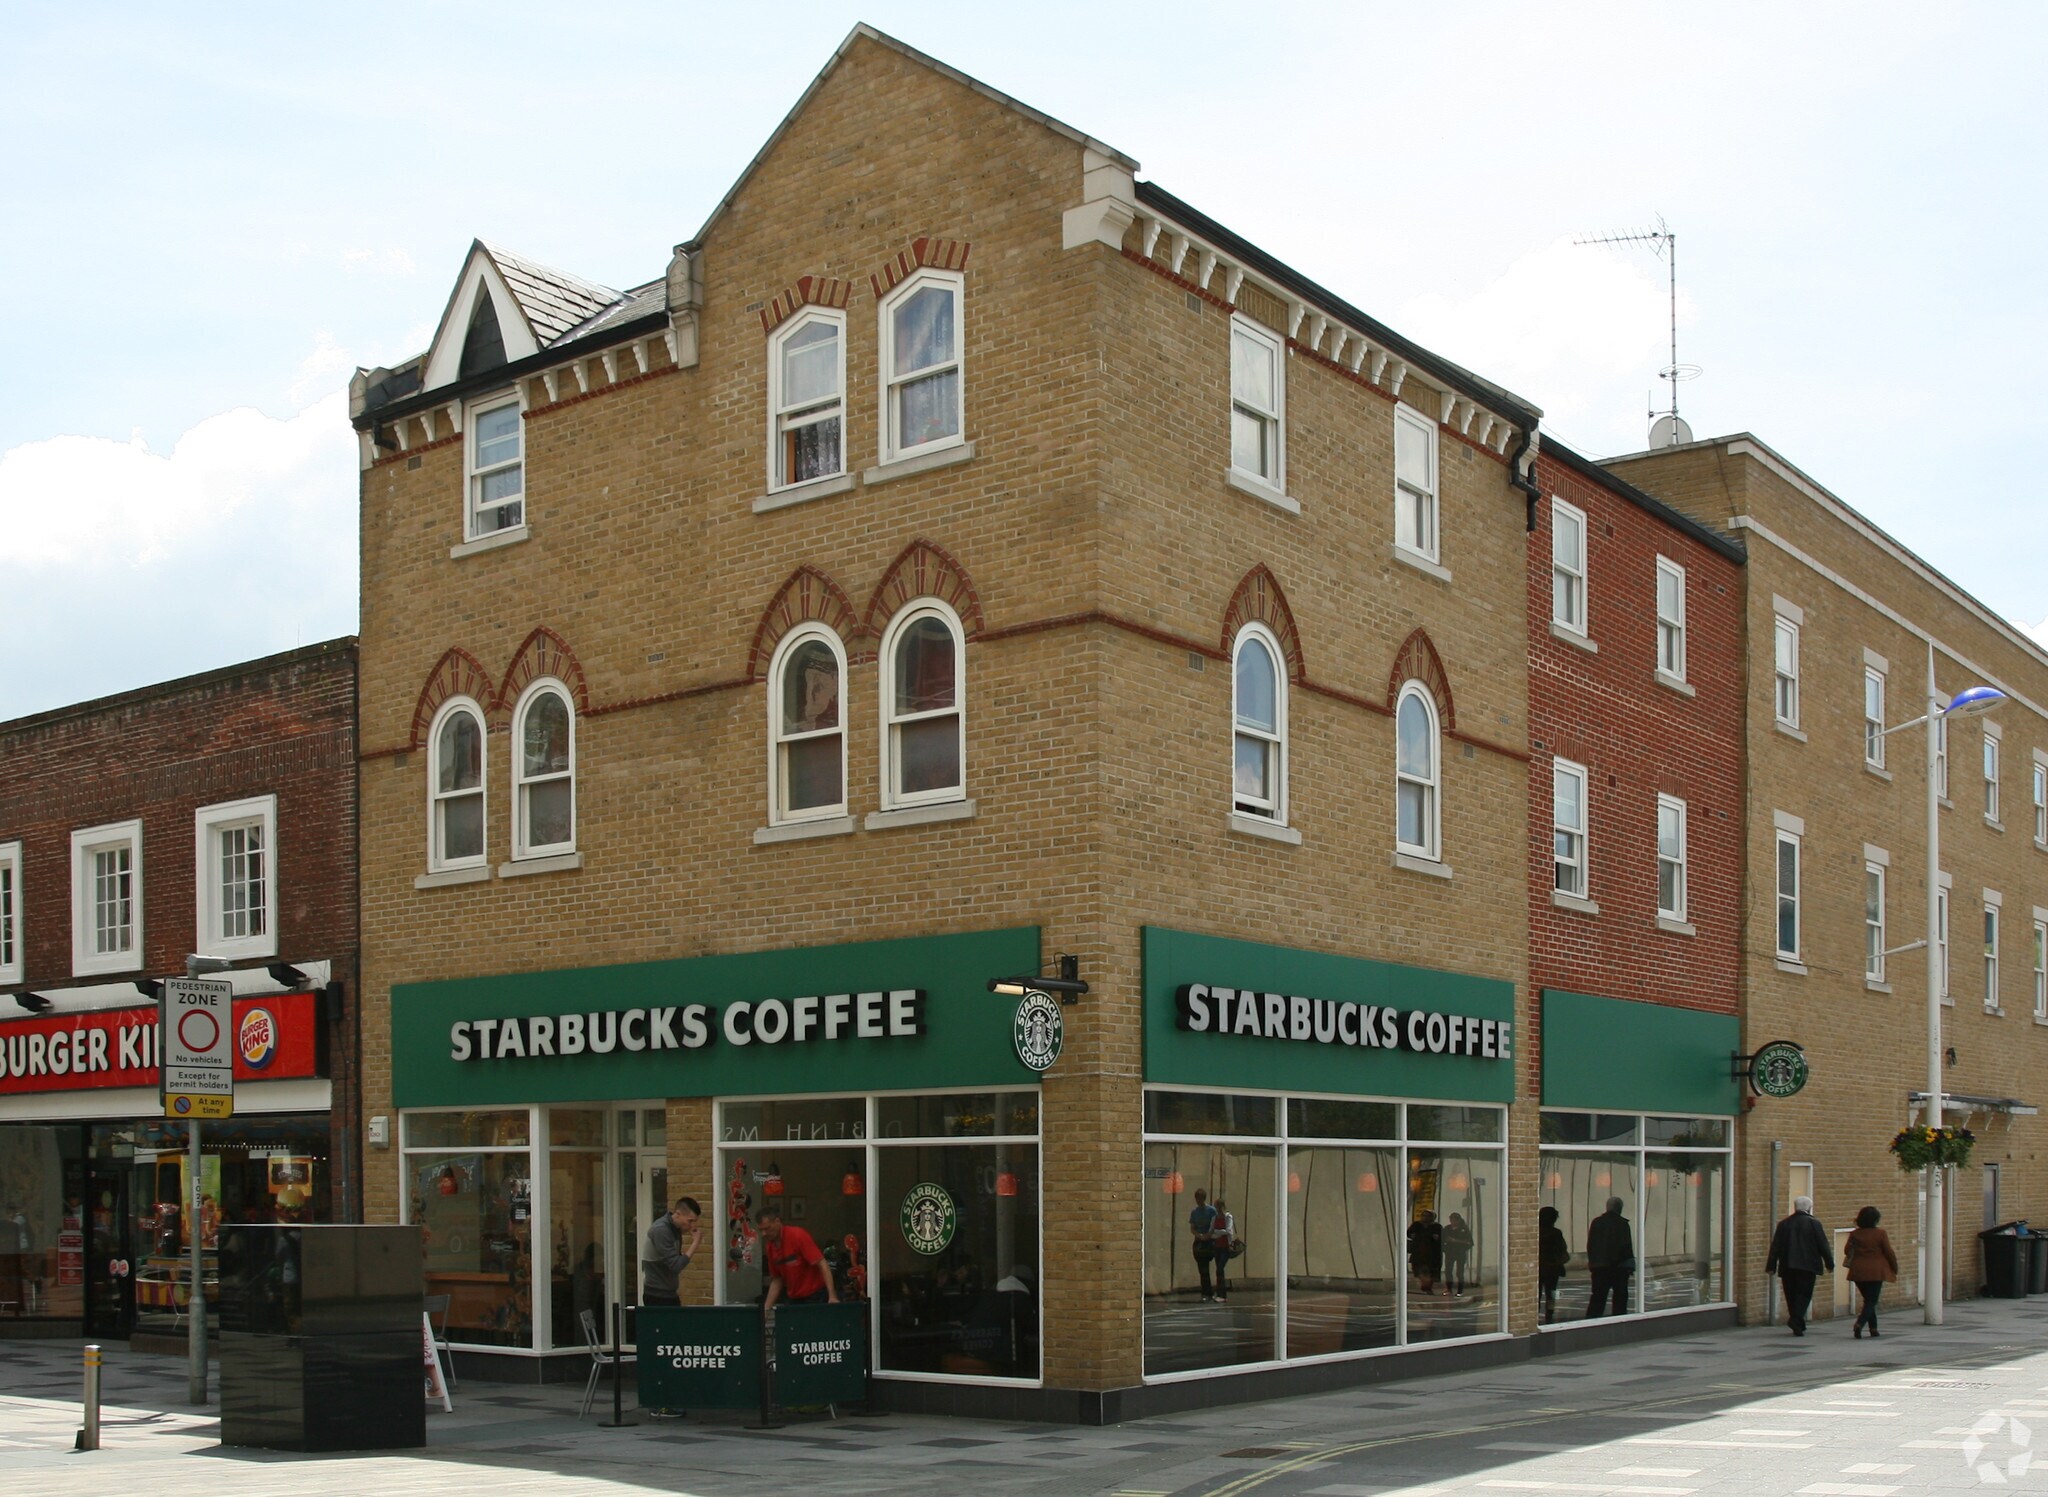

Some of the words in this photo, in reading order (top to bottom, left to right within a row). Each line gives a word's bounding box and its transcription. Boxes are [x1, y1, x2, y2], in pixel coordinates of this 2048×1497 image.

[170, 982, 226, 993] PEDESTRIAN
[178, 993, 218, 1006] ZONE
[1017, 995, 1061, 1029] STARBUCKS
[450, 1004, 709, 1062] STARBUCKS
[722, 989, 917, 1046] COFFEE
[1188, 983, 1399, 1049] STARBUCKS
[1407, 1010, 1511, 1060] COFFEE
[242, 1018, 269, 1041] BURGER
[242, 1028, 270, 1057] KING
[176, 1055, 188, 1063] No
[190, 1055, 223, 1064] vehicles
[1021, 1046, 1055, 1067] COFFEE
[1759, 1049, 1802, 1071] STARBUCKS
[178, 1071, 206, 1080] Except
[208, 1072, 221, 1080] for
[169, 1081, 197, 1089] permit
[199, 1081, 229, 1089] holders
[1763, 1082, 1797, 1094] COFFEE
[202, 1106, 220, 1114] time
[210, 1099, 225, 1107] any
[903, 1185, 953, 1217] STARBUCKS
[908, 1233, 947, 1252] COFFEE
[656, 1345, 742, 1357] STARBUCKS
[791, 1339, 851, 1355] STARBUCKS
[672, 1357, 726, 1369] COFFEE
[803, 1352, 843, 1366] COFFEE
